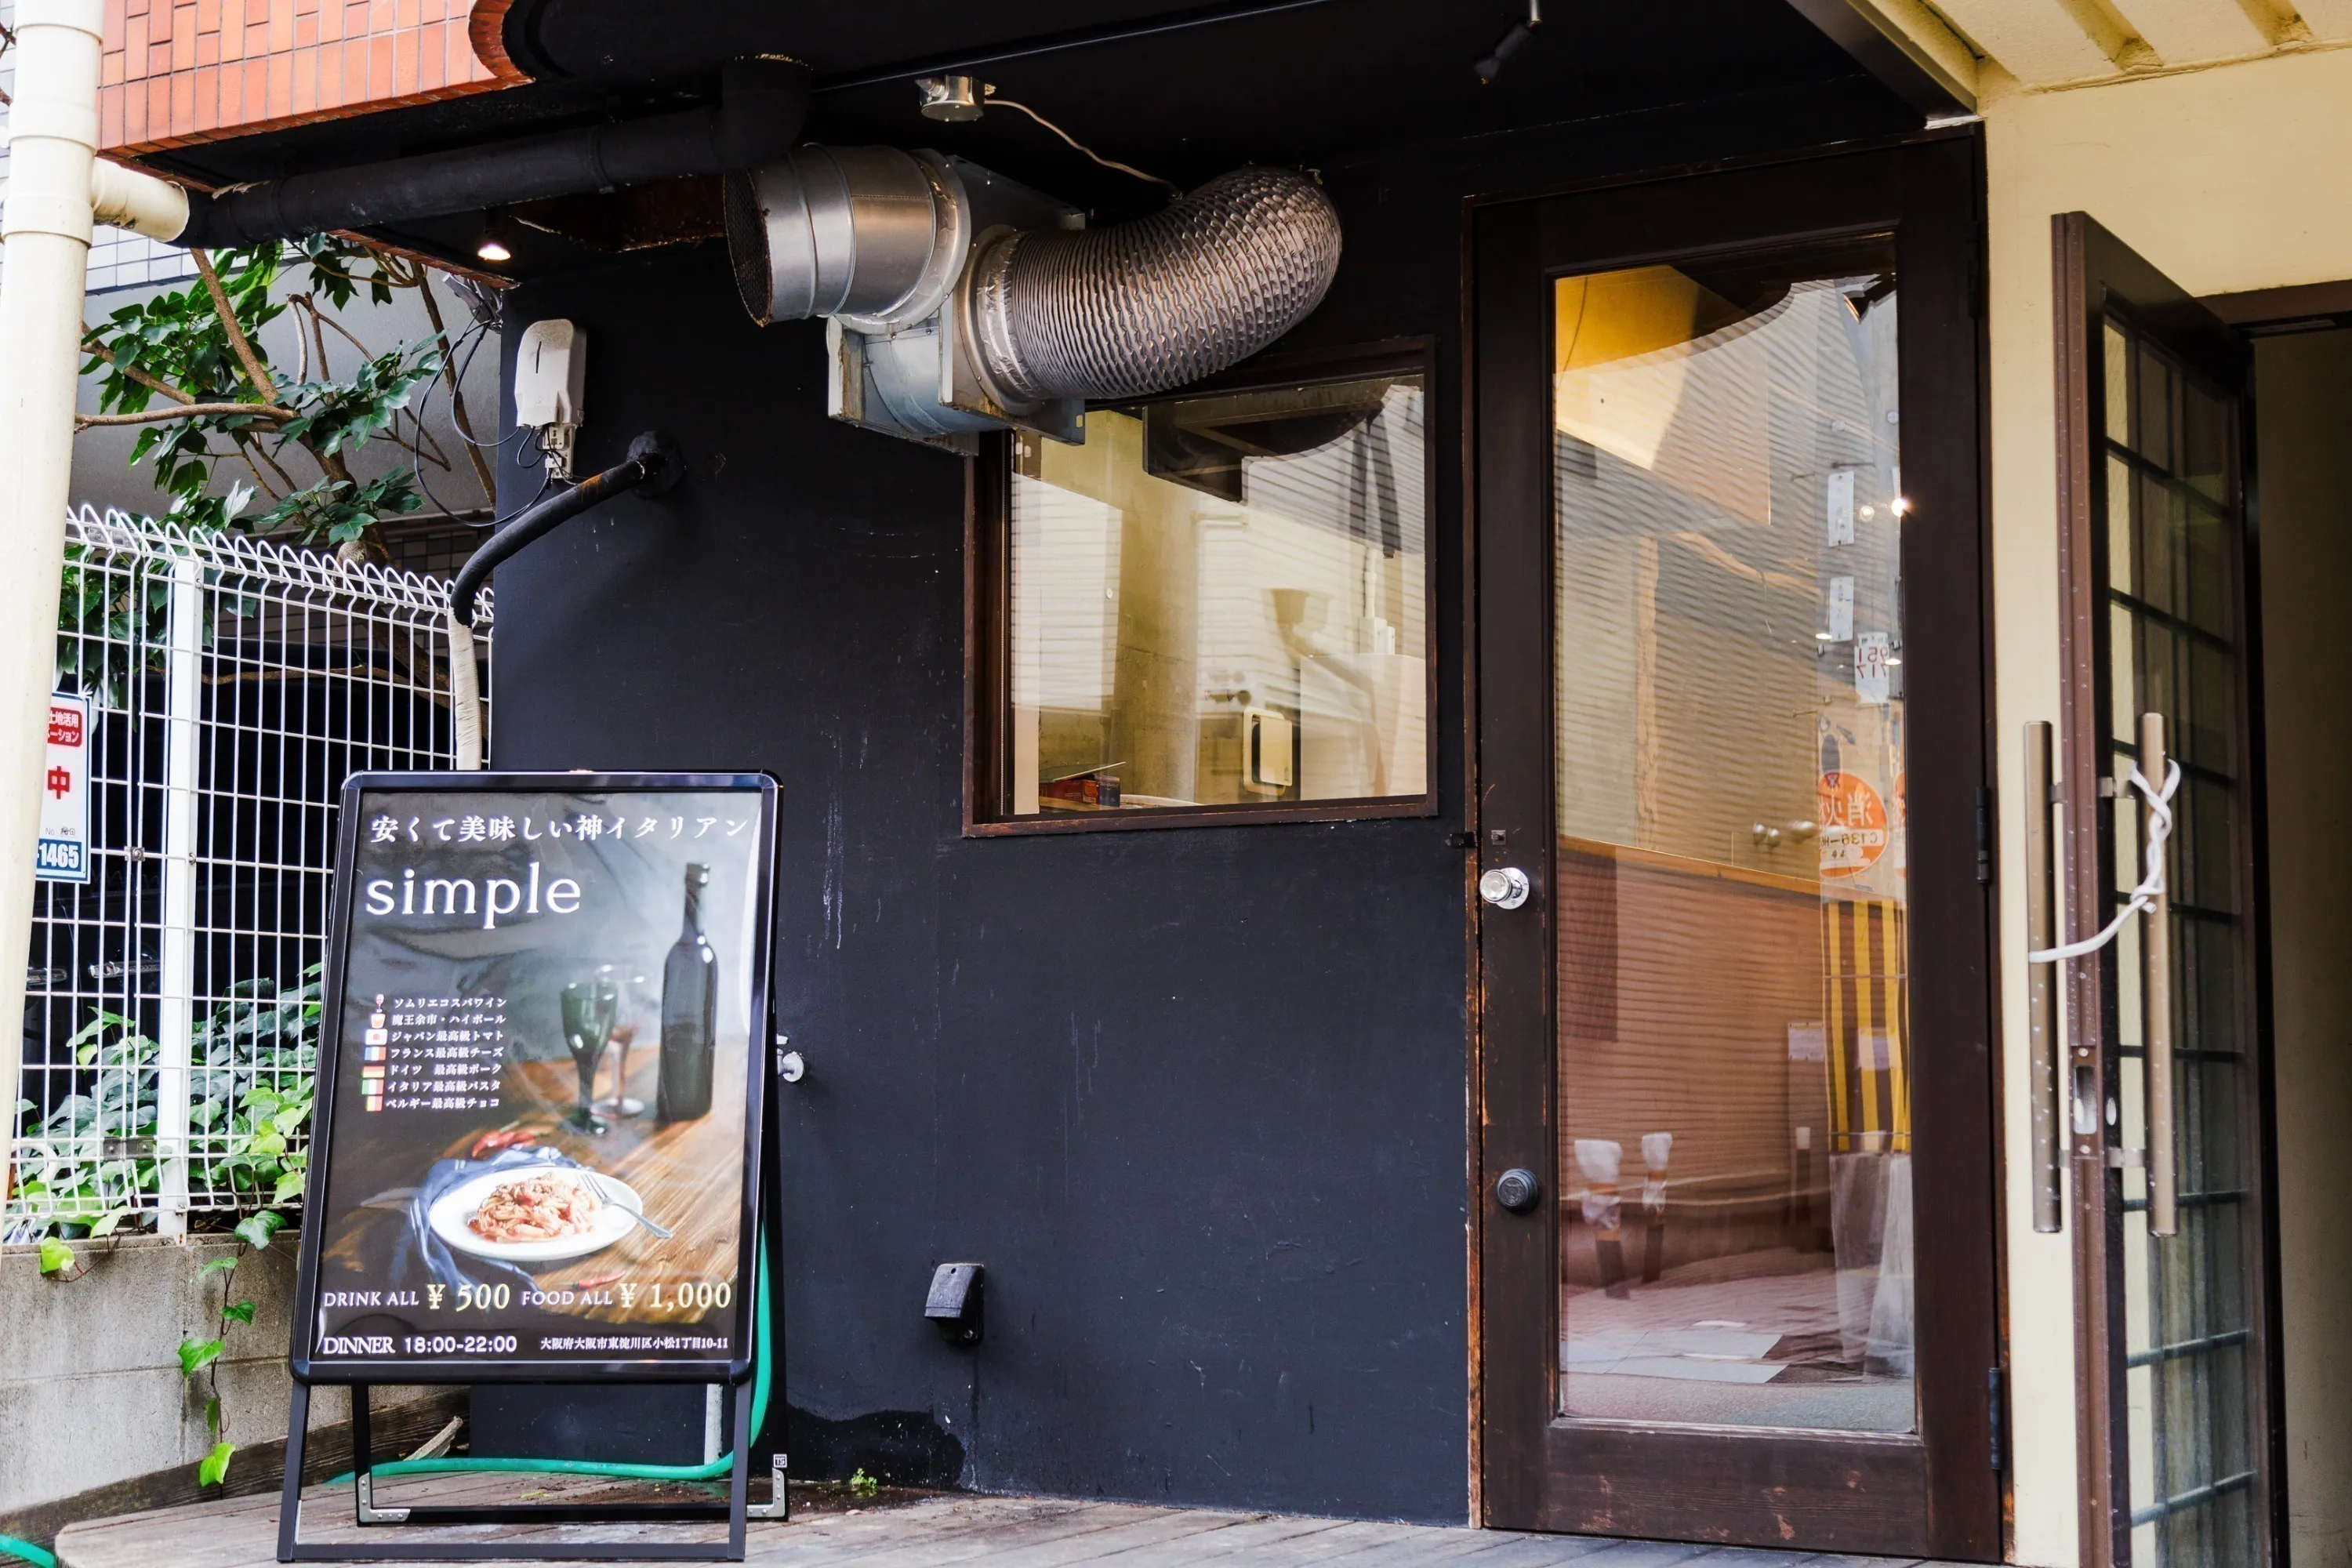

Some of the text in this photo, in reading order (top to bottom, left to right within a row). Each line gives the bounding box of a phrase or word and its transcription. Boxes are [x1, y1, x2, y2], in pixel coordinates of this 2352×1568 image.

[48, 726, 79, 743] ーション
[370, 815, 749, 844] 安くて美味しい神イタリアン
[365, 862, 582, 930] simple
[394, 997, 507, 1009] ソムリエコスパワイン
[391, 1030, 504, 1042] ジャパン最高級トマト
[390, 1047, 504, 1059] フランス最高級チーズ
[387, 1080, 501, 1094] イタリア最高級パスタ
[385, 1097, 500, 1110] ベルギー最高級チョコ
[323, 1291, 382, 1308] DRINK
[387, 1290, 419, 1307] ALL
[521, 1290, 575, 1305] FOOD
[579, 1290, 614, 1305] ALL
[322, 1336, 396, 1355] DINNER
[403, 1335, 518, 1355] 18:00-22:00
